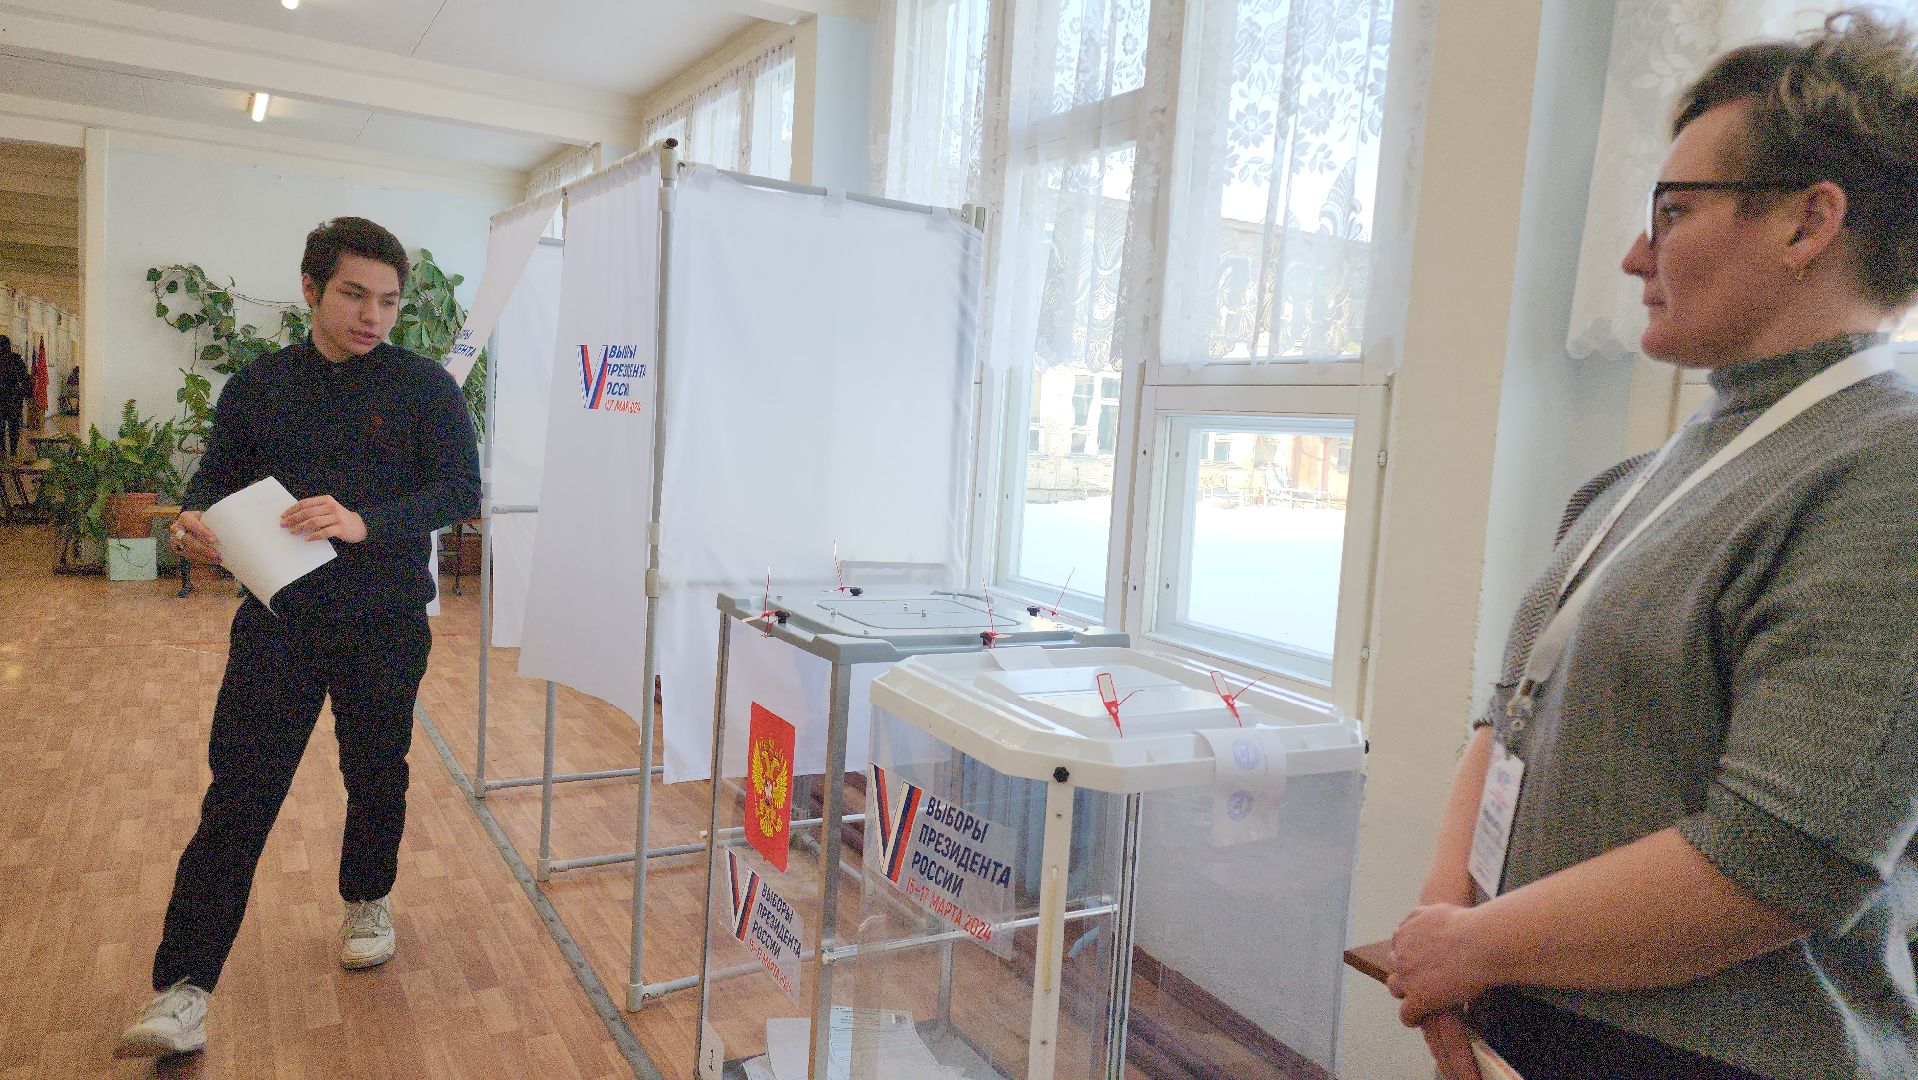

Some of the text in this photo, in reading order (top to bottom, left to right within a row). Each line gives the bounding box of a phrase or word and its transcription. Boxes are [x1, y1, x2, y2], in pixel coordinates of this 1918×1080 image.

[925, 796, 989, 844] ВЫБОРЫ
[911, 850, 965, 898] РОССИИ
[919, 823, 1012, 888] ПРЕЗИДЕНТА
[762, 882, 794, 925] ВЫБОРЫ
[929, 892, 963, 925] МАРТА
[963, 915, 992, 942] 2024
[752, 919, 782, 959] РОССИИ
[757, 902, 802, 959] ПРЕЗИДЕНТА
